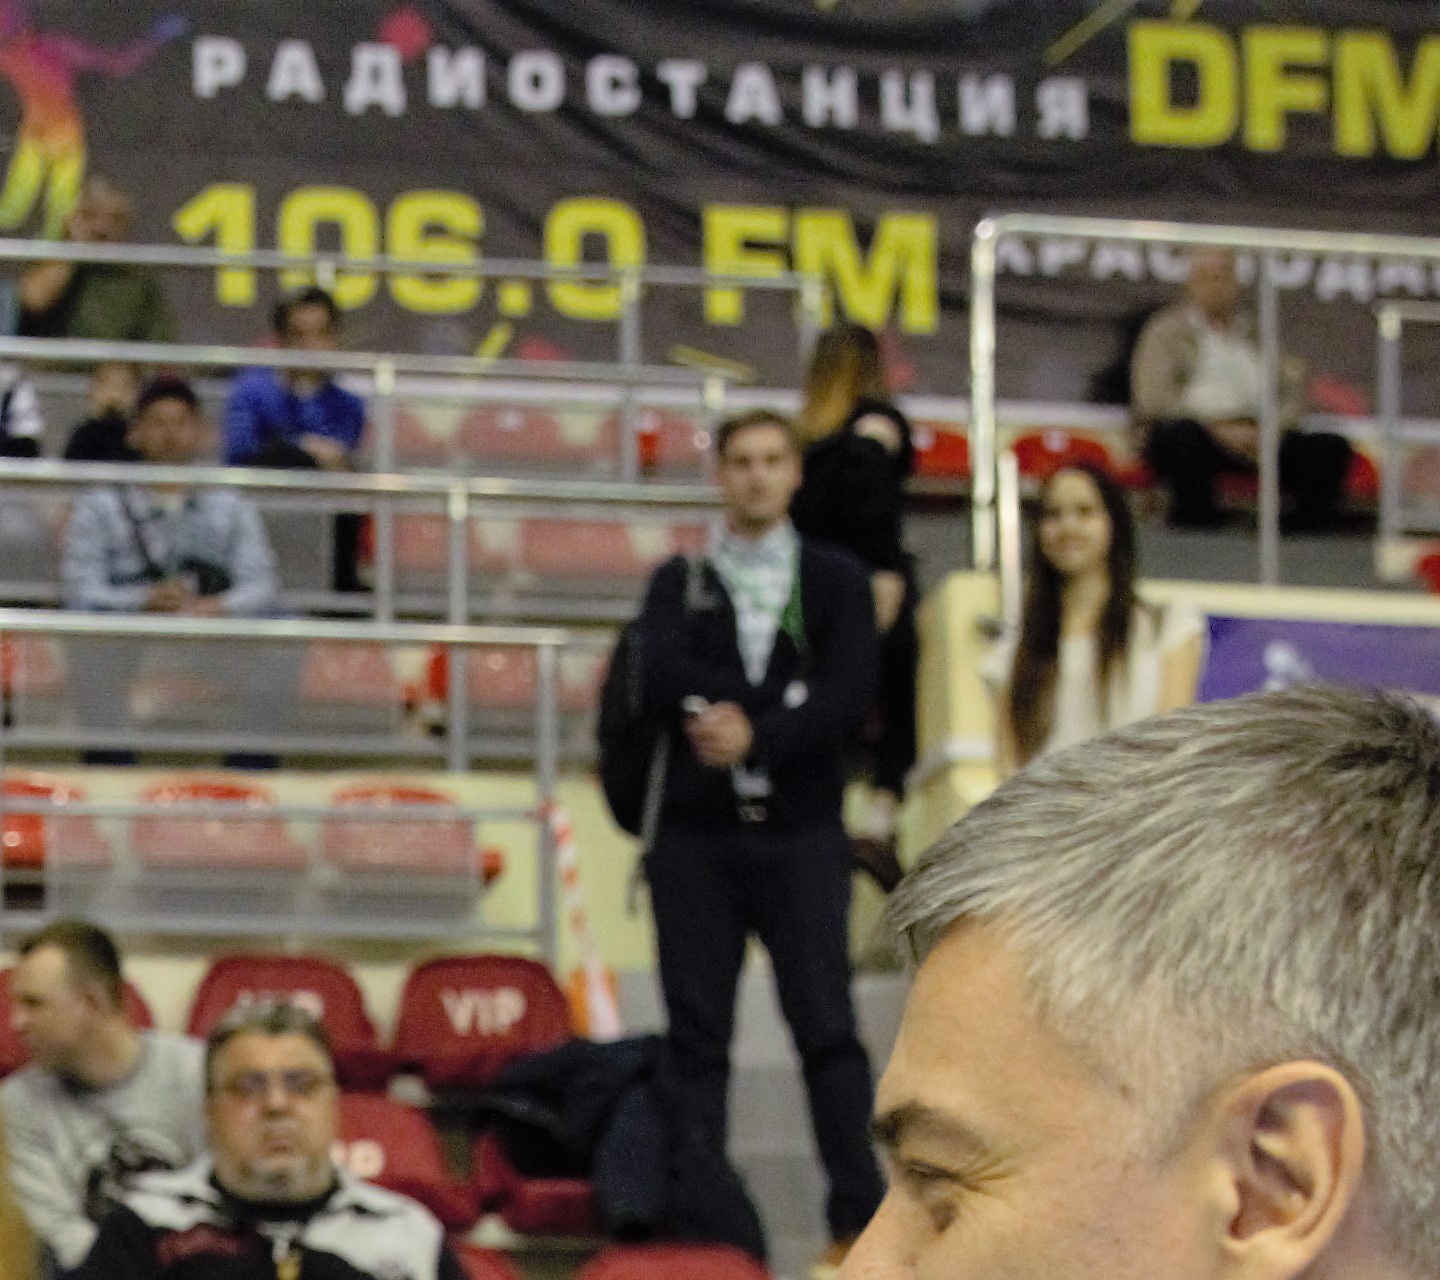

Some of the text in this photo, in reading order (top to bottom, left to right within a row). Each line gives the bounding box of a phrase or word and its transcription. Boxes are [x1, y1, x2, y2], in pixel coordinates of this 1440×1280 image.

[192, 34, 1090, 140] РАДИОСТАНЦИЯ
[174, 182, 939, 334] 106.0 FM
[439, 985, 528, 1037] VIP
